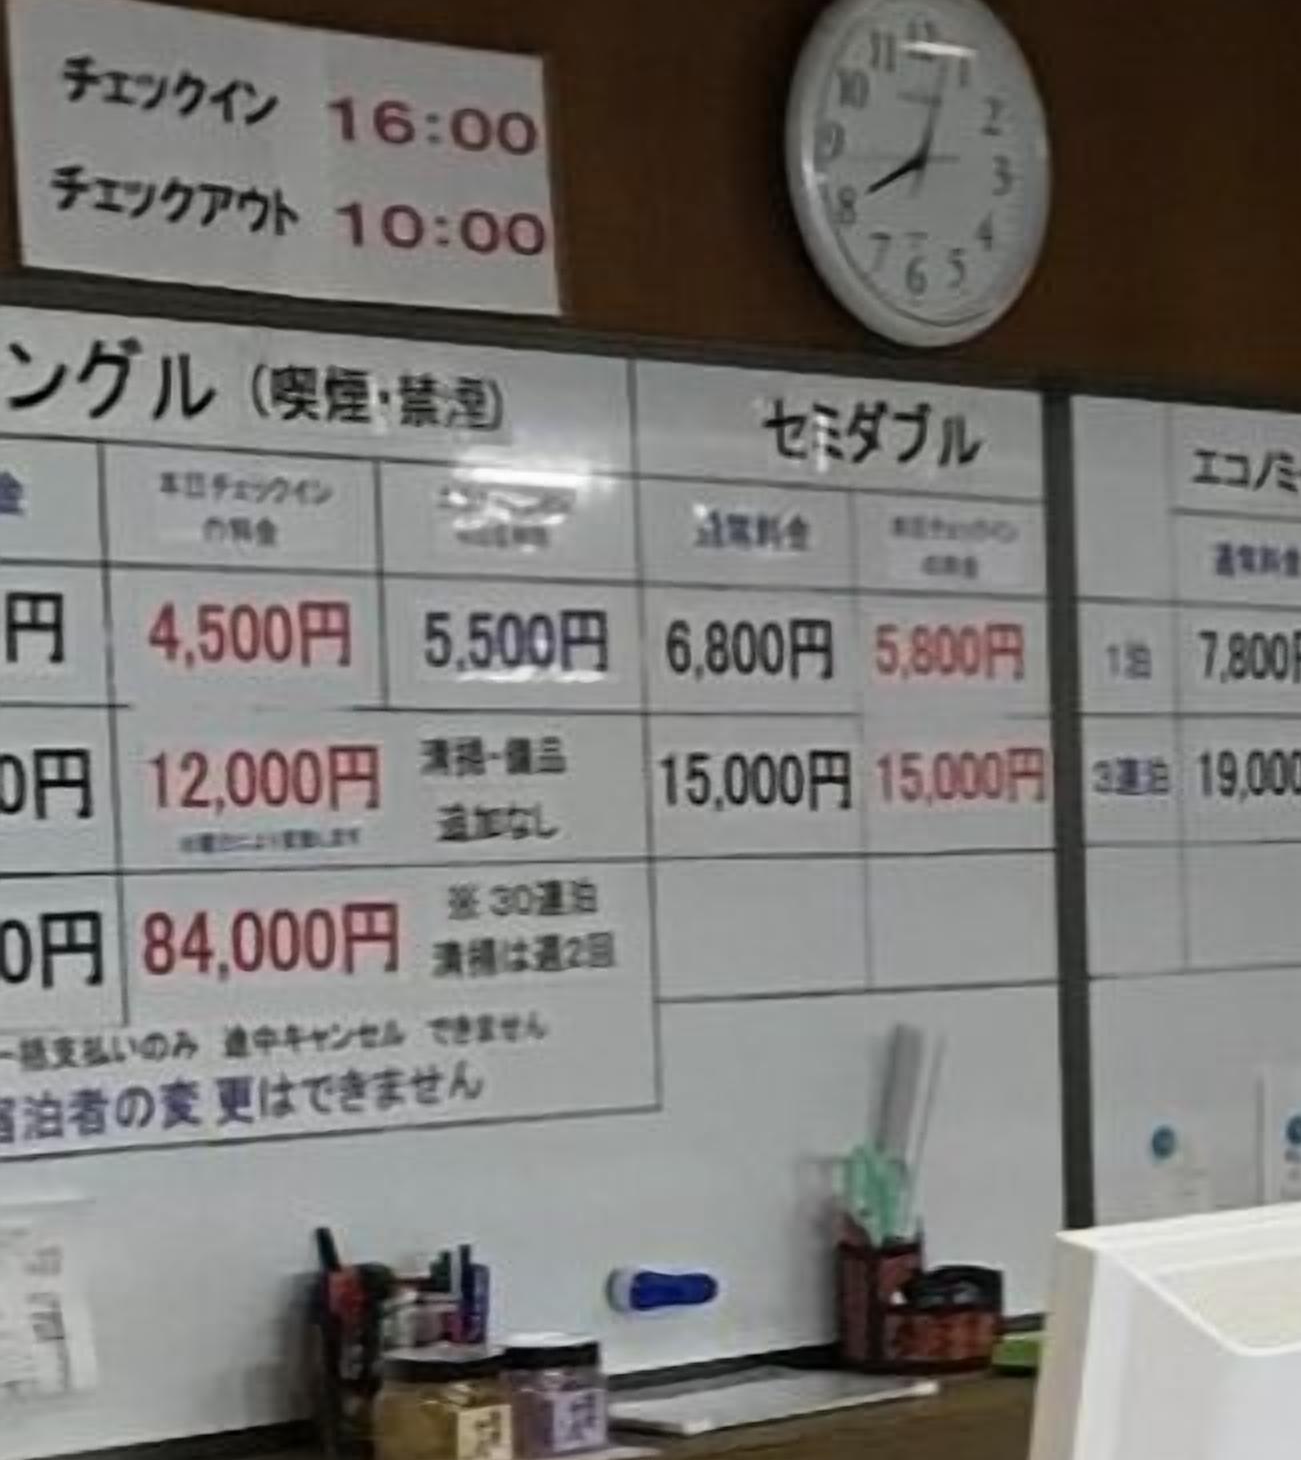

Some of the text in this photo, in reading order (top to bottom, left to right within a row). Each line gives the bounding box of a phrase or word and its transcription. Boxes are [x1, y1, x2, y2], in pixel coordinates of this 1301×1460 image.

[61, 54, 539, 158] チェックイン 16:00
[50, 163, 547, 256] チェックアウト 10:00
[904, 254, 928, 297] 6
[7, 337, 216, 420] ングル
[762, 397, 988, 468] セミダブル
[148, 599, 352, 670] 4,500円
[423, 608, 609, 672] 5,500円
[666, 617, 834, 681] 6,800円
[875, 622, 1026, 681] 5,800円
[149, 744, 382, 816] 12,000円
[659, 748, 852, 812] 15,000円
[876, 746, 1046, 809] 15,000円
[142, 901, 401, 981] 84,000円
